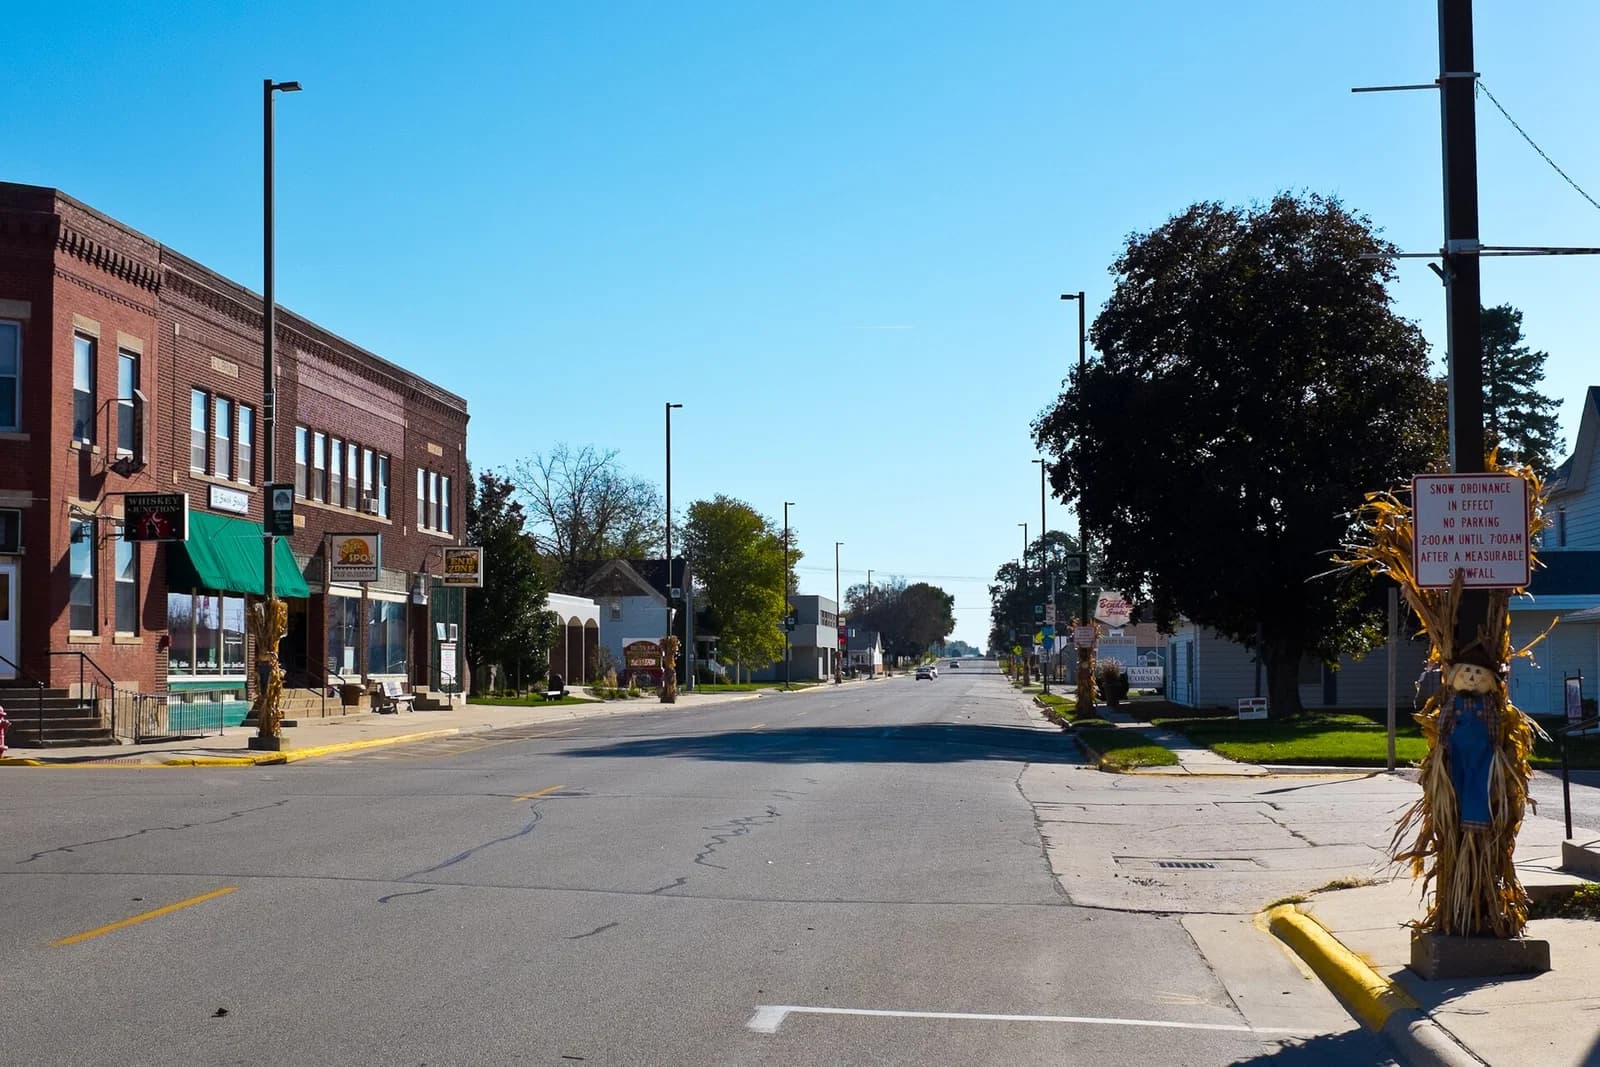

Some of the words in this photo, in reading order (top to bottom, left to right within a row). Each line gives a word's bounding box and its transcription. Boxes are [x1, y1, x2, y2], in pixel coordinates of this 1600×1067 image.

[1430, 483, 1455, 495] SNOW
[1460, 482, 1511, 494] ORDINANCE
[128, 496, 178, 505] WHISKEY
[1448, 501, 1457, 511] IN
[1462, 500, 1494, 511] EFFECT
[1443, 517, 1455, 528] NO
[1461, 517, 1500, 528] PARKING
[1459, 534, 1485, 545] UNTIL
[450, 557, 473, 565] END
[1420, 552, 1449, 562] AFTER
[1454, 551, 1460, 561] A
[1465, 550, 1524, 561] MEASURABLE
[448, 565, 474, 573] ZONE
